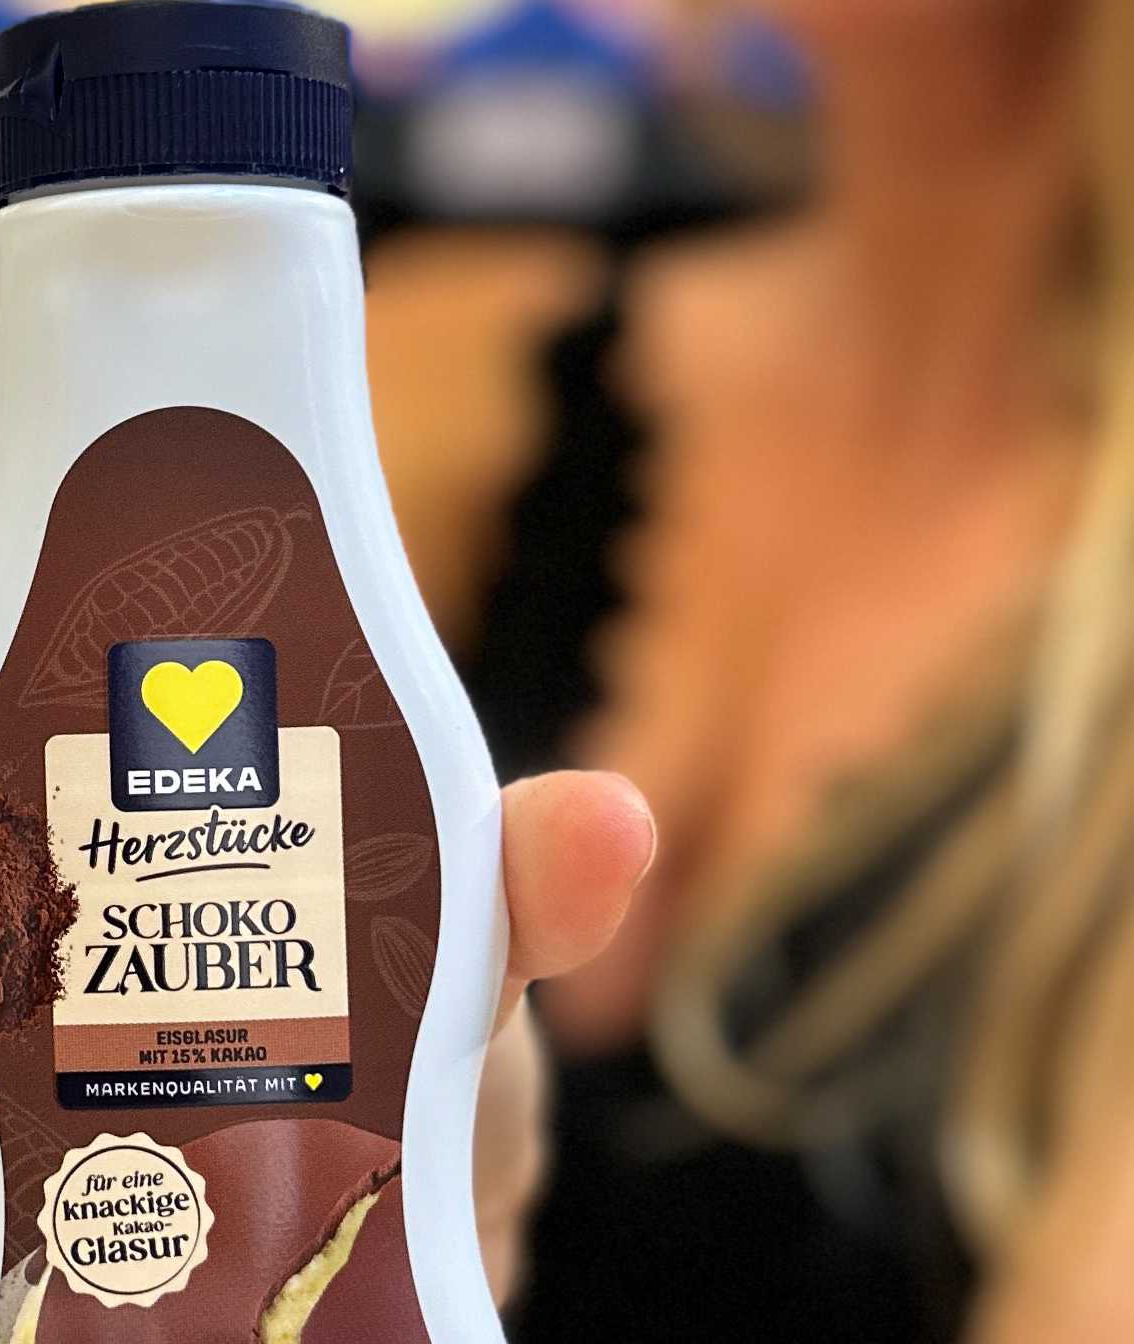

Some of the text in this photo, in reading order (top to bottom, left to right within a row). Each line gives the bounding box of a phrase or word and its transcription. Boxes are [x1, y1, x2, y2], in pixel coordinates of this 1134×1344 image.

[127, 766, 262, 795] EDEKA
[79, 810, 316, 874] Herzstücke
[103, 899, 297, 940] SCHOKO
[83, 939, 321, 994] ZAUBER
[156, 1028, 249, 1045] EISGLASUR
[139, 1049, 168, 1065] MIT
[210, 1046, 267, 1063] KAKAO
[85, 1074, 298, 1098] MARKENQUALITÄT MIT
[80, 1170, 165, 1197] für eine
[63, 1189, 190, 1223] knackige
[112, 1219, 173, 1236] Kakao-
[70, 1232, 189, 1267] Glasur
